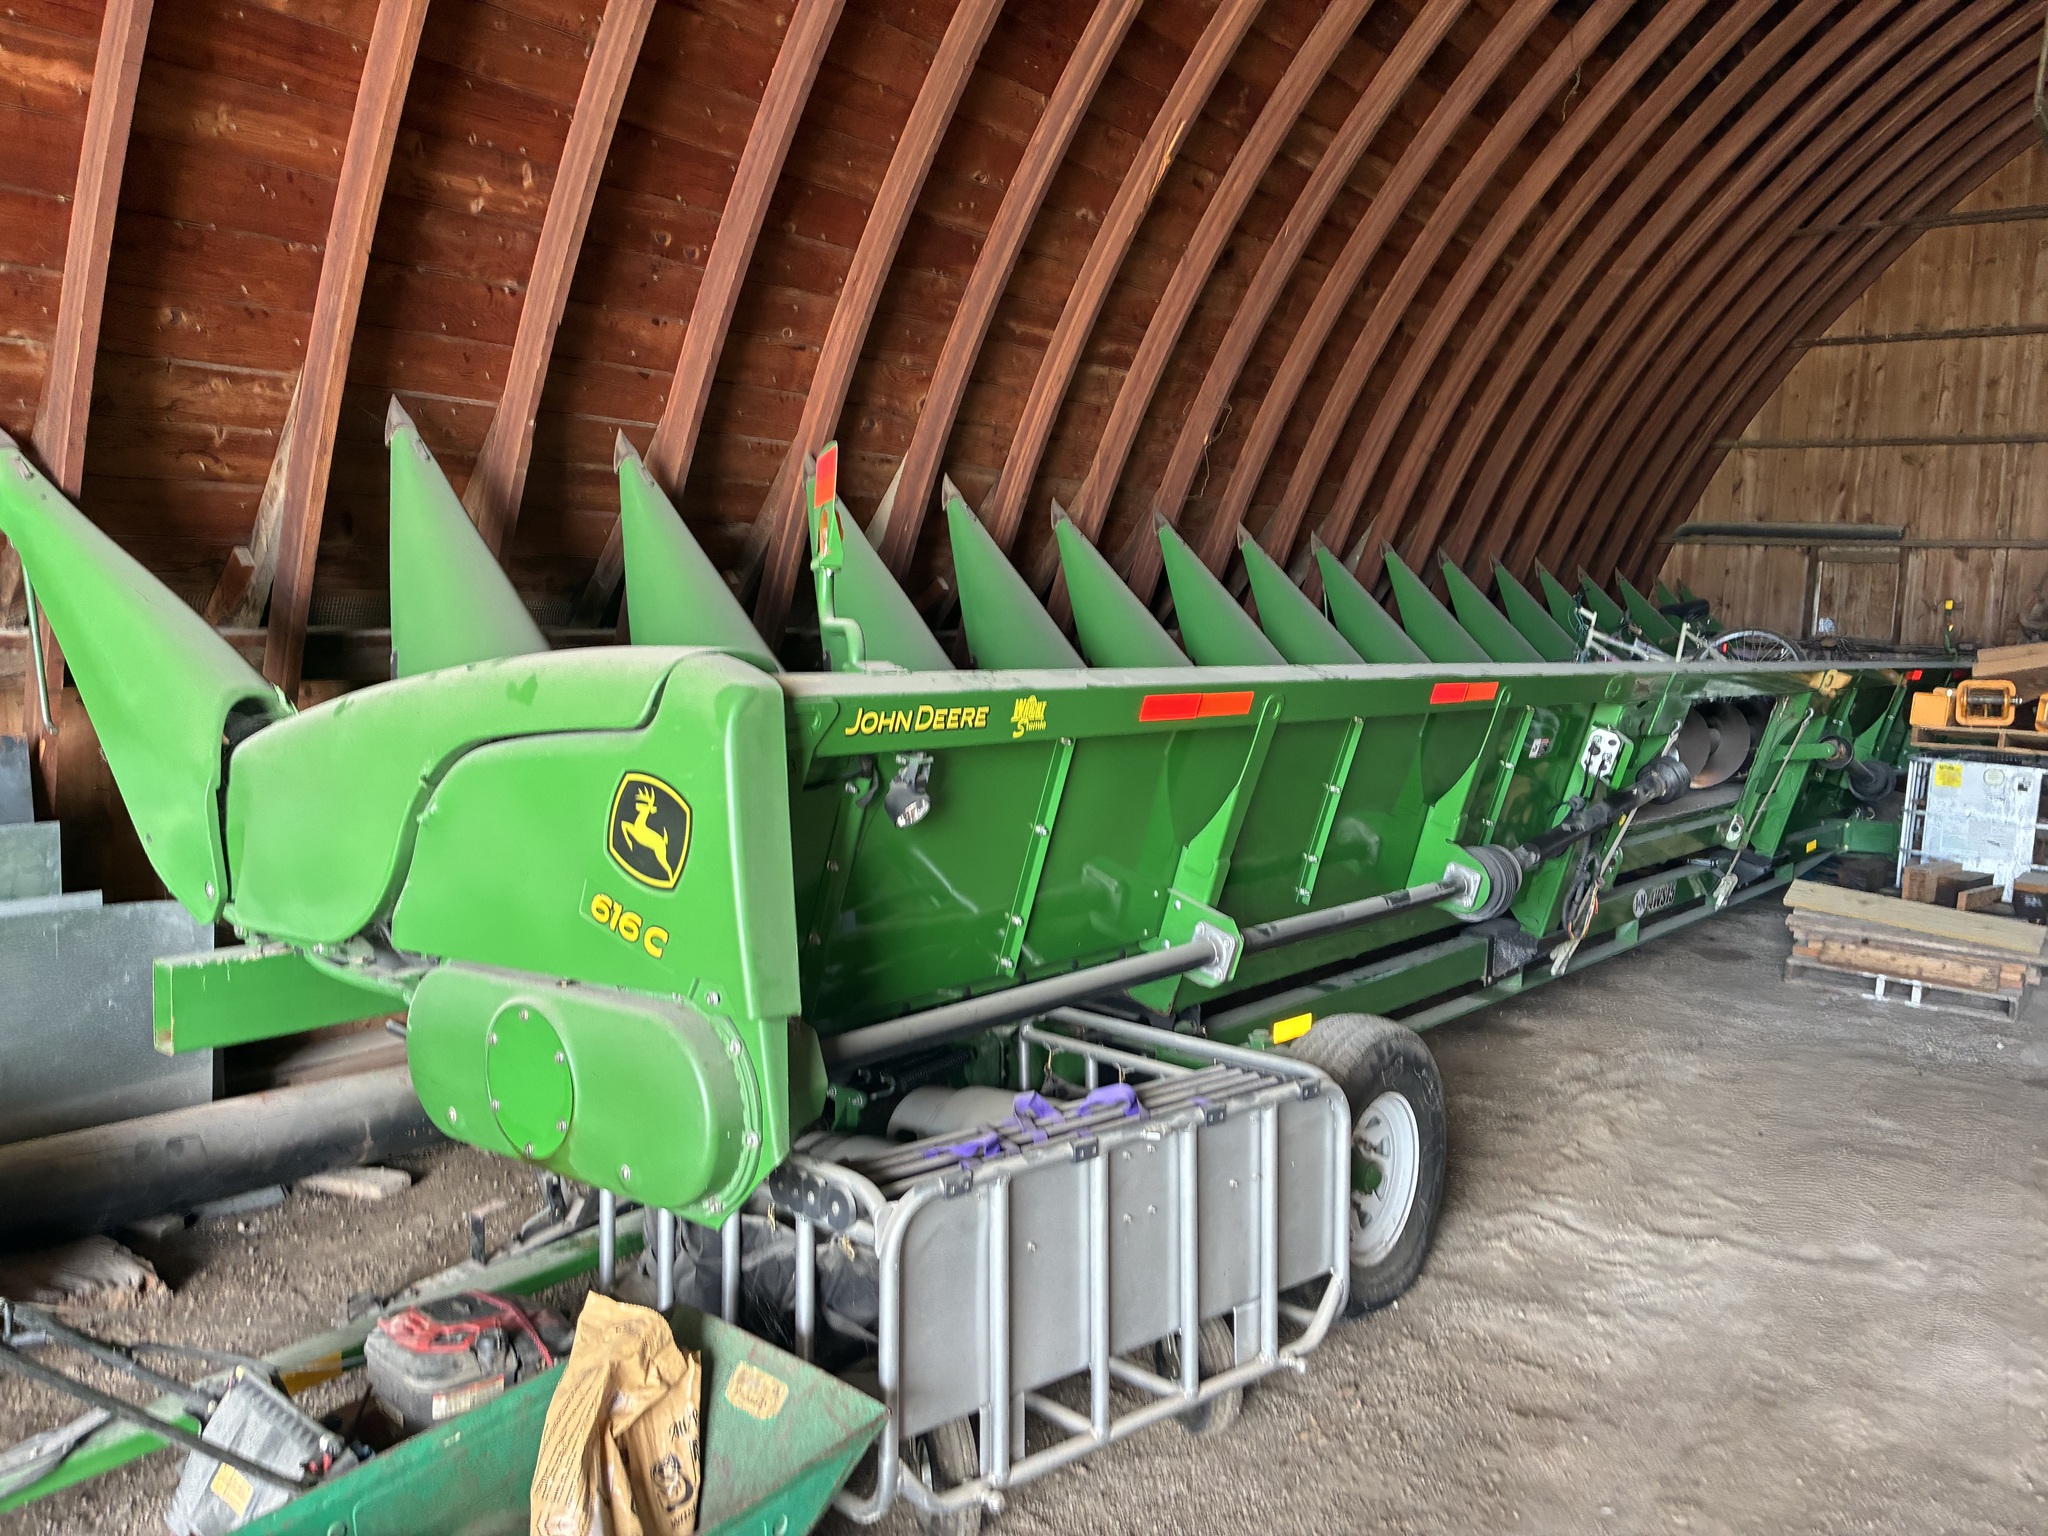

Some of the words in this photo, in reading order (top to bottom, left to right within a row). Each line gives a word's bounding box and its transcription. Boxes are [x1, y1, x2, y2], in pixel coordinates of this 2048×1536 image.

[845, 707, 914, 736] JOHN
[915, 704, 990, 732] DEERE
[590, 893, 643, 943] 616
[643, 925, 669, 959] C
